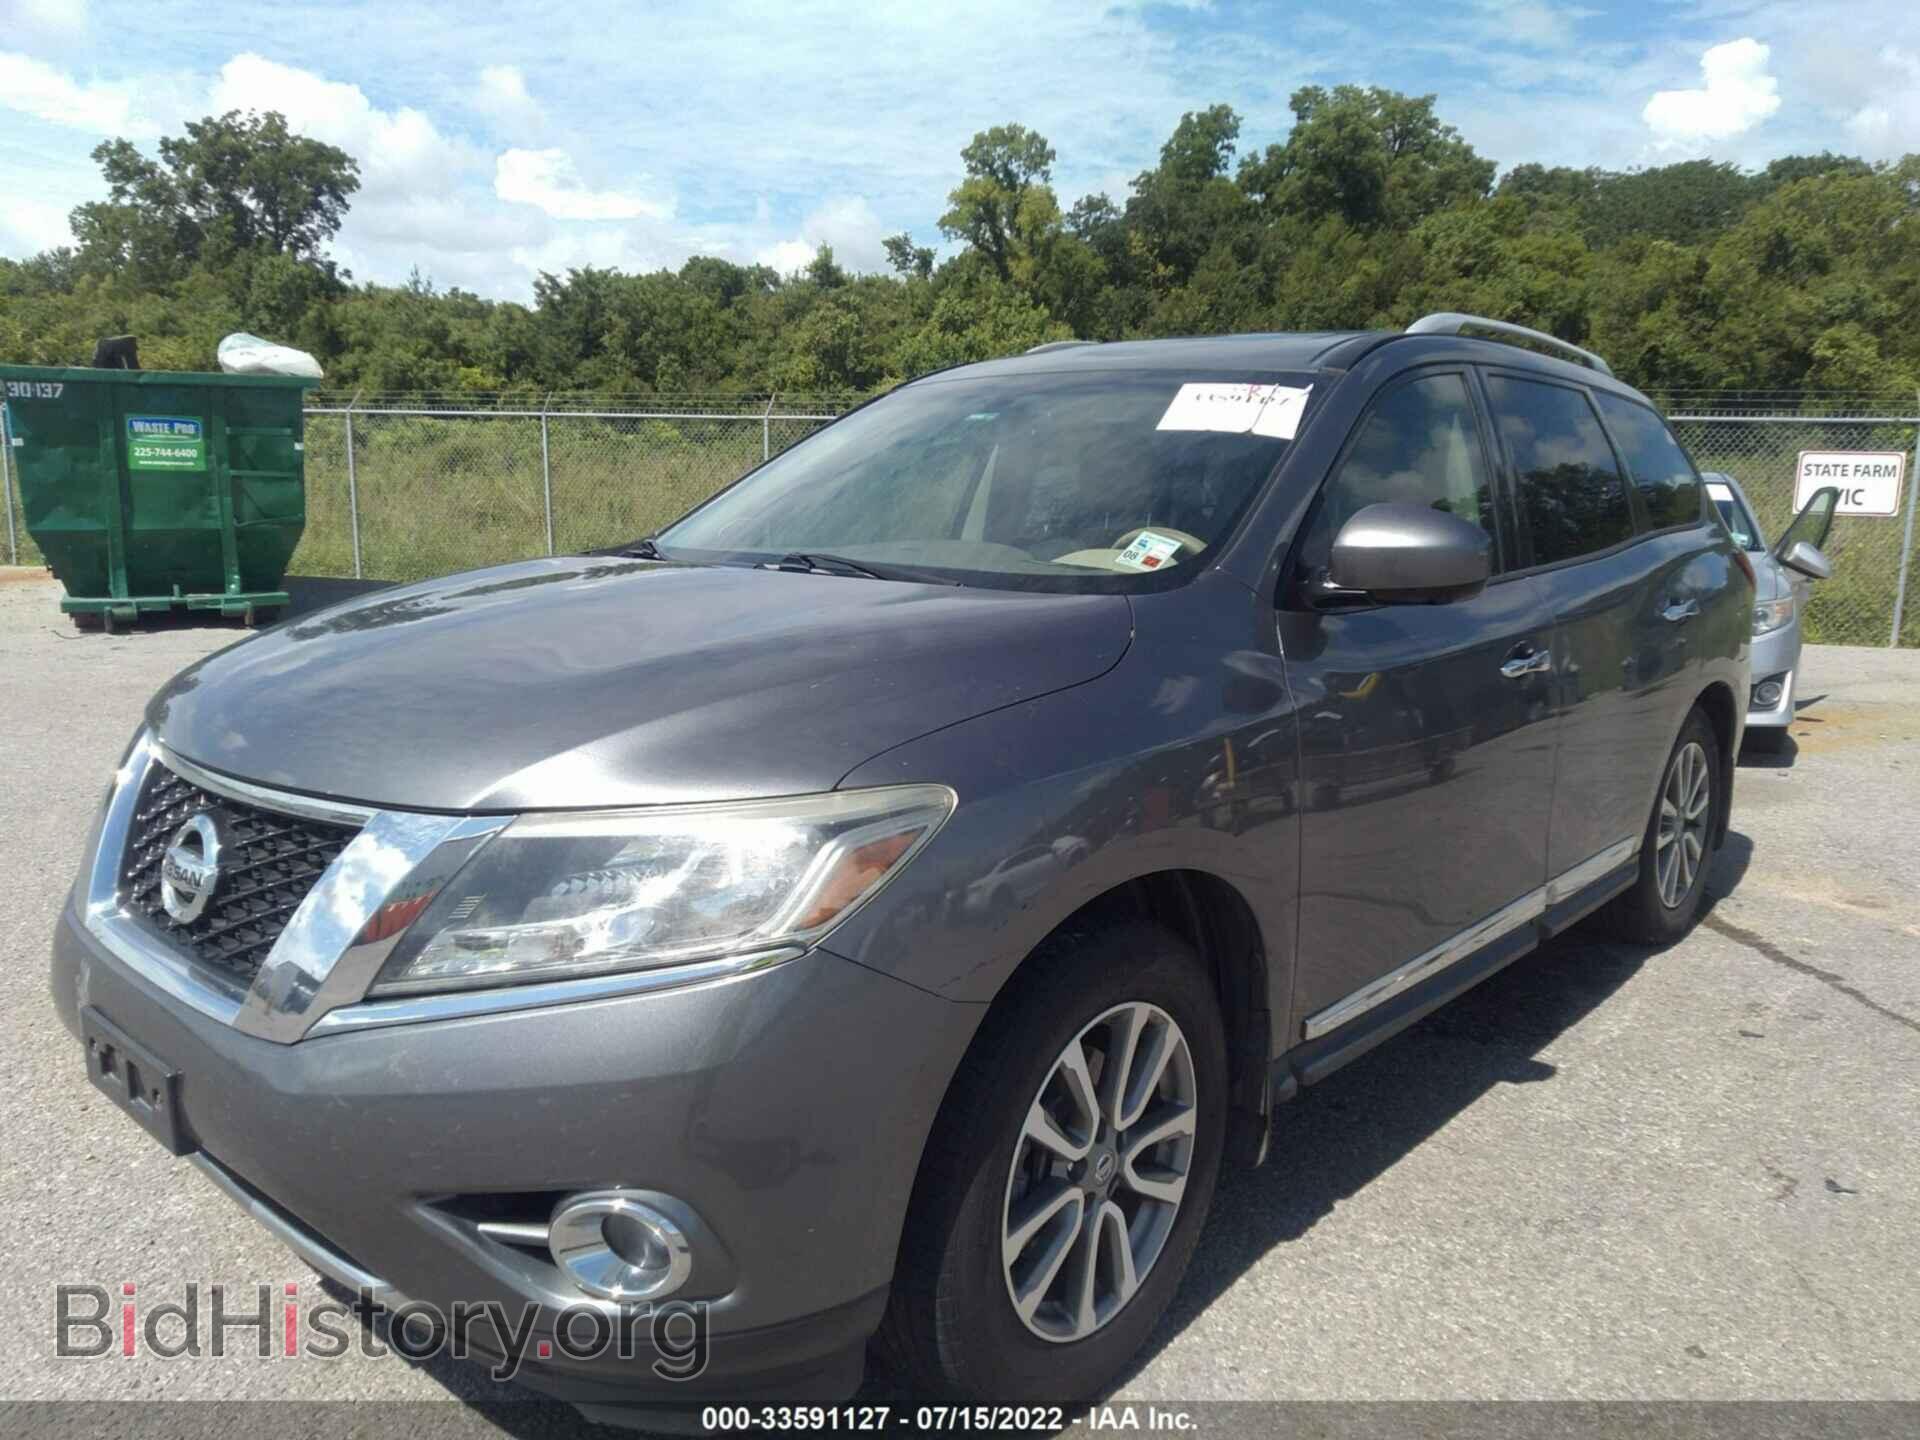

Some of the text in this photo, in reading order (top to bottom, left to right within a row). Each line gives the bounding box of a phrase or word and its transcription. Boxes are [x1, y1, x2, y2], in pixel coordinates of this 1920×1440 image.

[132, 421, 170, 433] WASTE
[133, 447, 198, 458] 225-744-6400
[1803, 463, 1897, 478] STATE FARM
